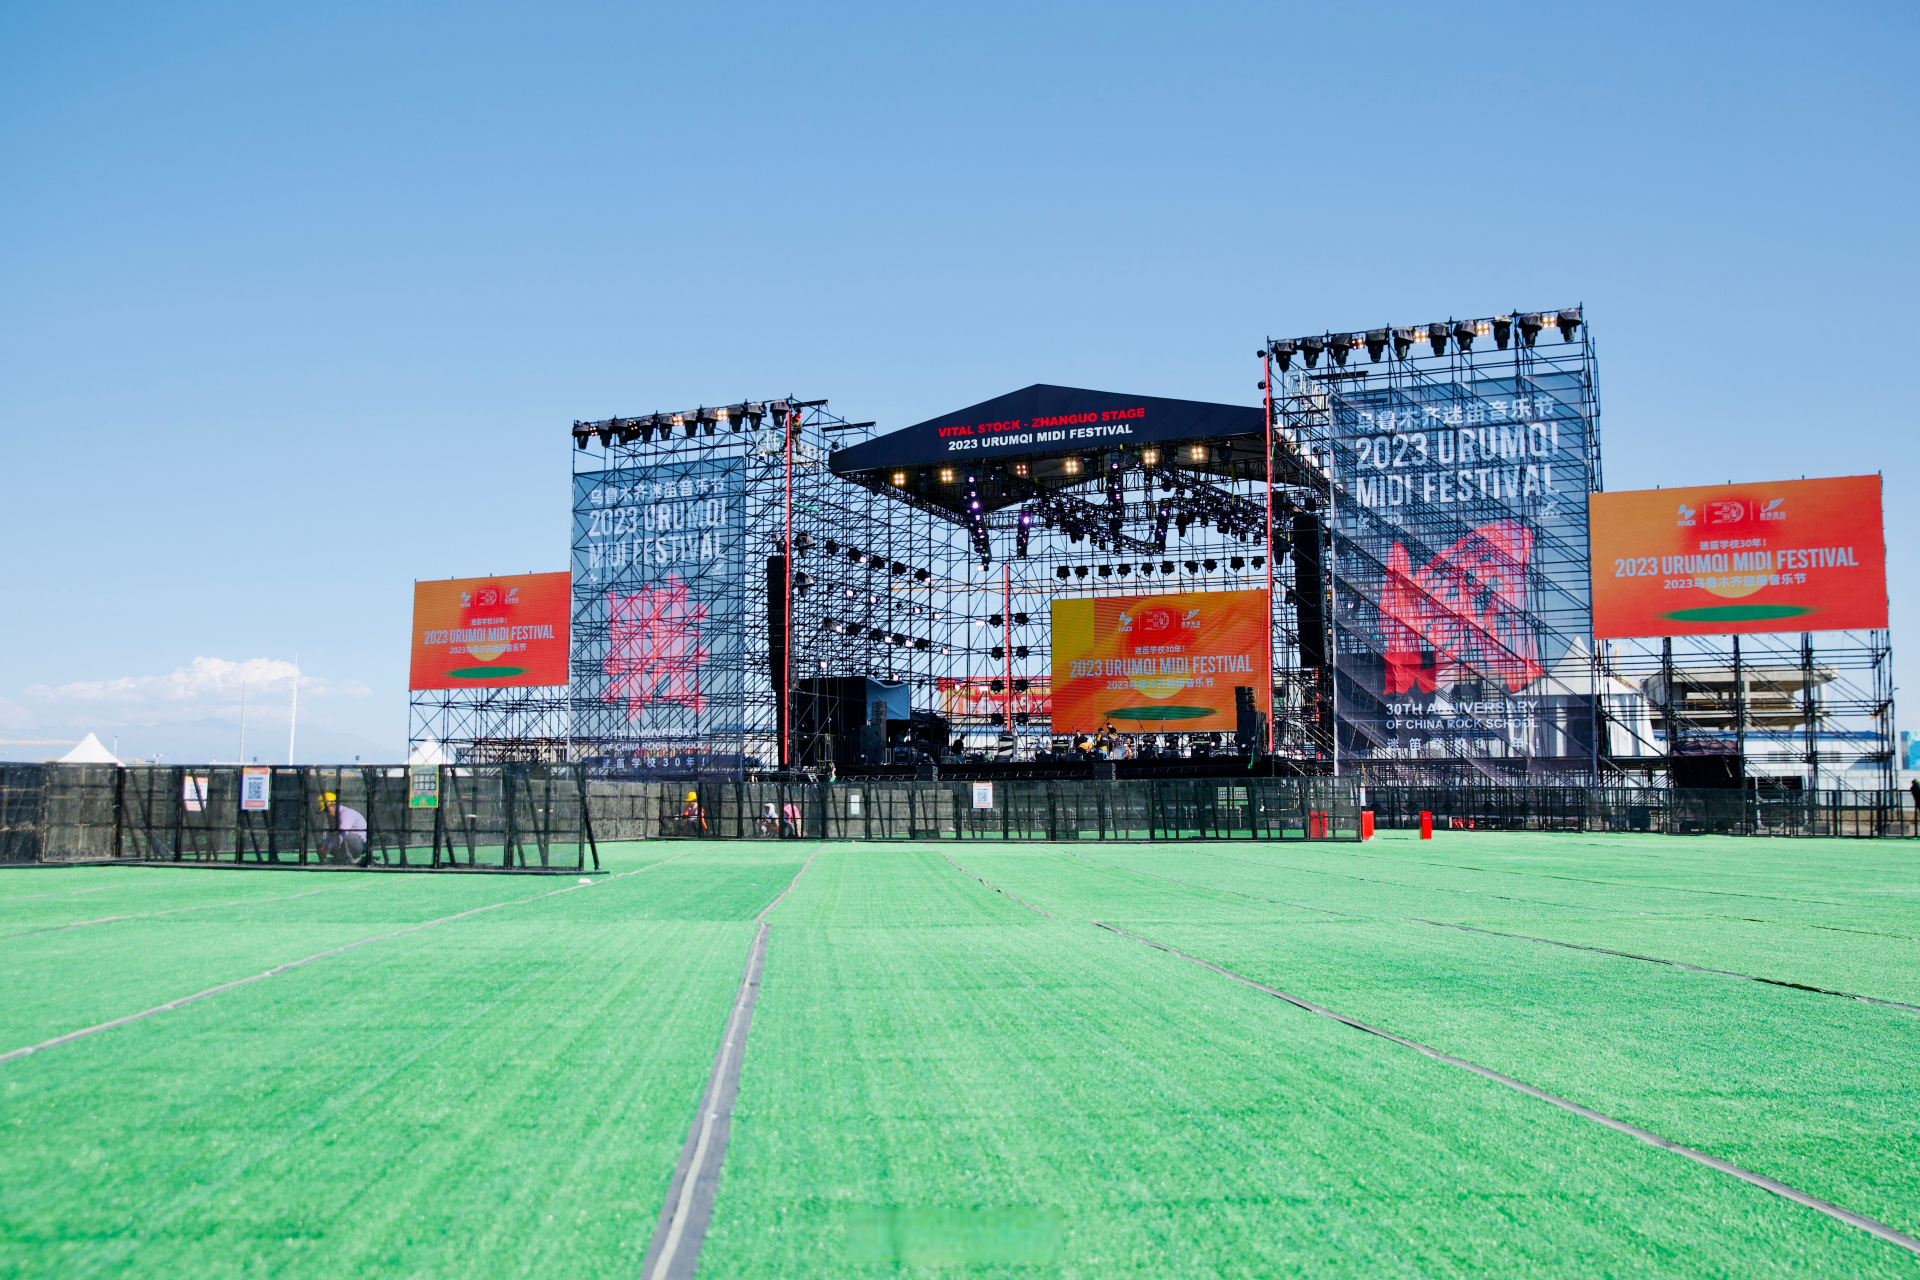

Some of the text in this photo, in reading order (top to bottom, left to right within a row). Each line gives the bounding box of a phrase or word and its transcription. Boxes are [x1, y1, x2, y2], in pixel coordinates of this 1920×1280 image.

[938, 425, 975, 438] VITAL
[978, 420, 1021, 434] STOCK
[1031, 412, 1098, 428] ZHANGUO
[1101, 407, 1146, 421] STAGE
[1357, 396, 1555, 431] 乌鲁木齐迷笛音乐节
[948, 424, 1133, 451] 2023 URUMQI MIDI FESTIVAL
[1355, 422, 1559, 470] 2023 URUMQI
[590, 477, 725, 505] 乌鲁木齐迷笛音乐节
[1355, 464, 1560, 508] MIDI FESTIVAL
[589, 498, 727, 537] 2023 URUMQI
[589, 532, 726, 569] MIDI FESTIVAL
[1699, 538, 1767, 551] 迷笛学校30年！
[1614, 547, 1859, 578] 2023 URUMQI MIDI FESTIVAL
[1663, 573, 1807, 590] 2023乌鲁木齐迷笛音乐节
[424, 625, 555, 645] 2023 URUMQI MIDI FESTIVAL
[1069, 654, 1254, 678] 2023 URUMQI MIDI FESTIVAL
[1385, 701, 1540, 715] 30TH ANNIVERSARY
[1385, 718, 1540, 730] OF CHINA ROCK SCHOOL
[615, 742, 641, 751] CHINA
[642, 741, 668, 750] ROCK
[670, 741, 706, 750] SCHOOL
